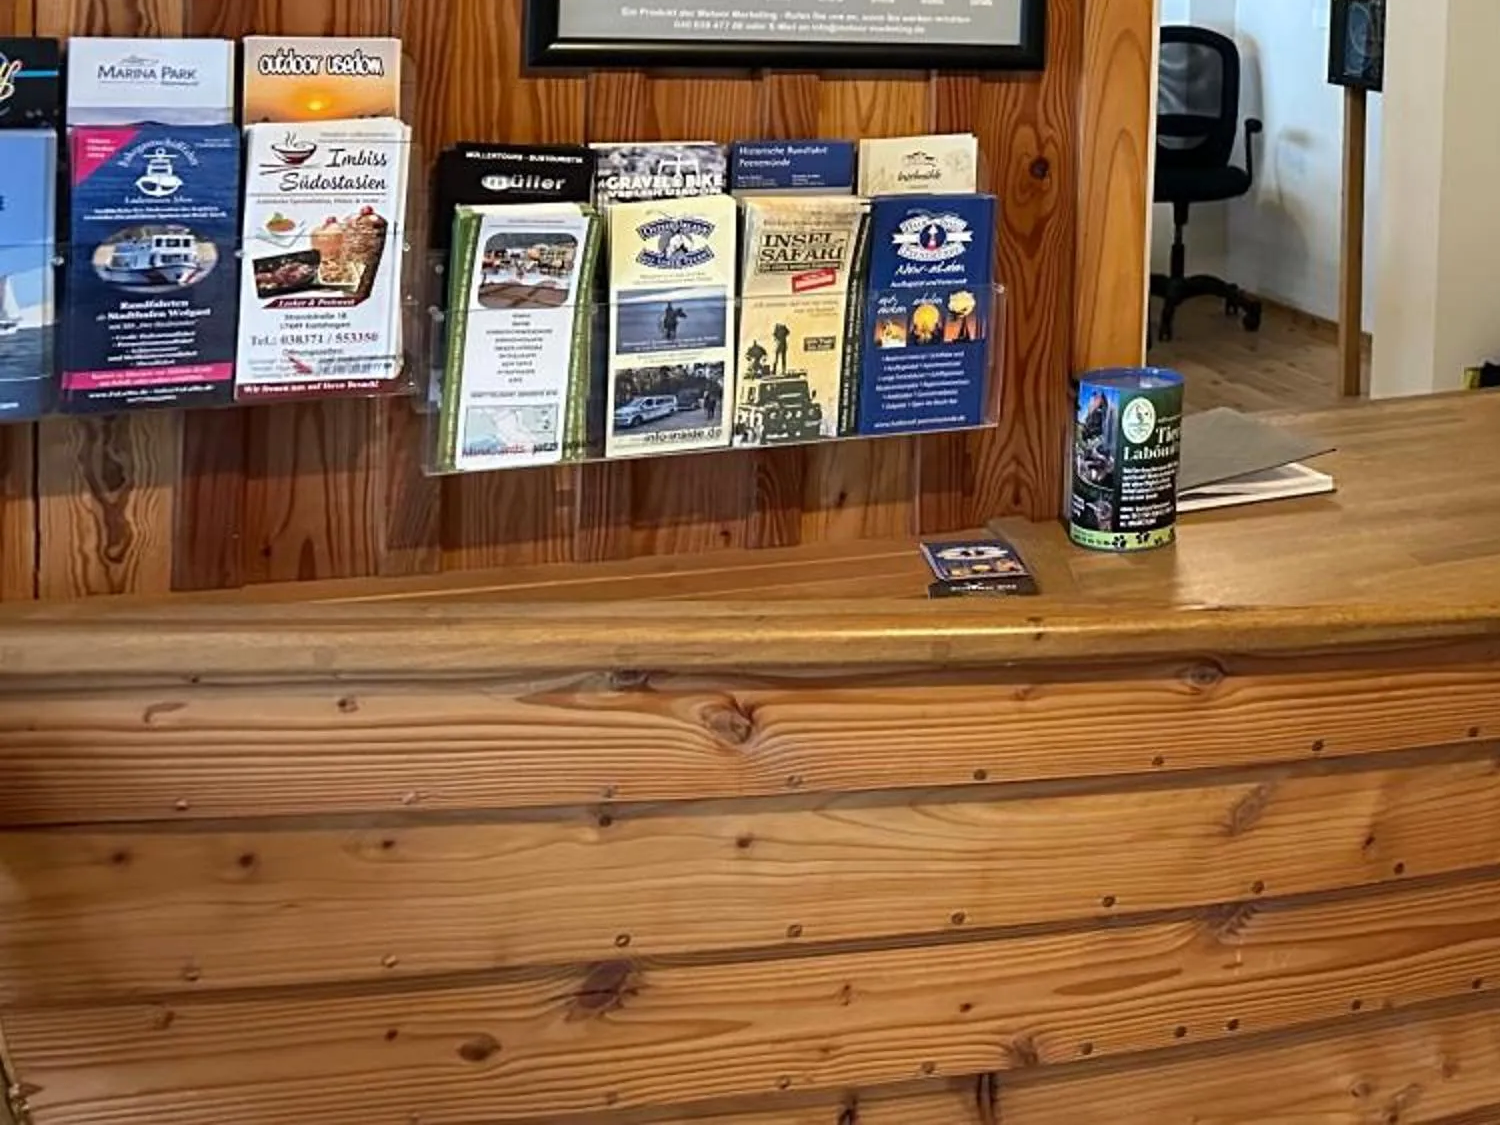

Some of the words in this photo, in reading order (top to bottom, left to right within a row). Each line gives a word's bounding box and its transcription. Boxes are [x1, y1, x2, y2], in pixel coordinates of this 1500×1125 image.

[258, 47, 322, 75] outdoor
[326, 48, 384, 77] usedom
[97, 64, 157, 80] MARINA
[160, 65, 197, 80] PARK
[325, 148, 387, 168] Imbiss
[279, 172, 387, 192] Südostasien
[763, 232, 845, 248] INSEL-
[760, 246, 843, 262] SAFARI
